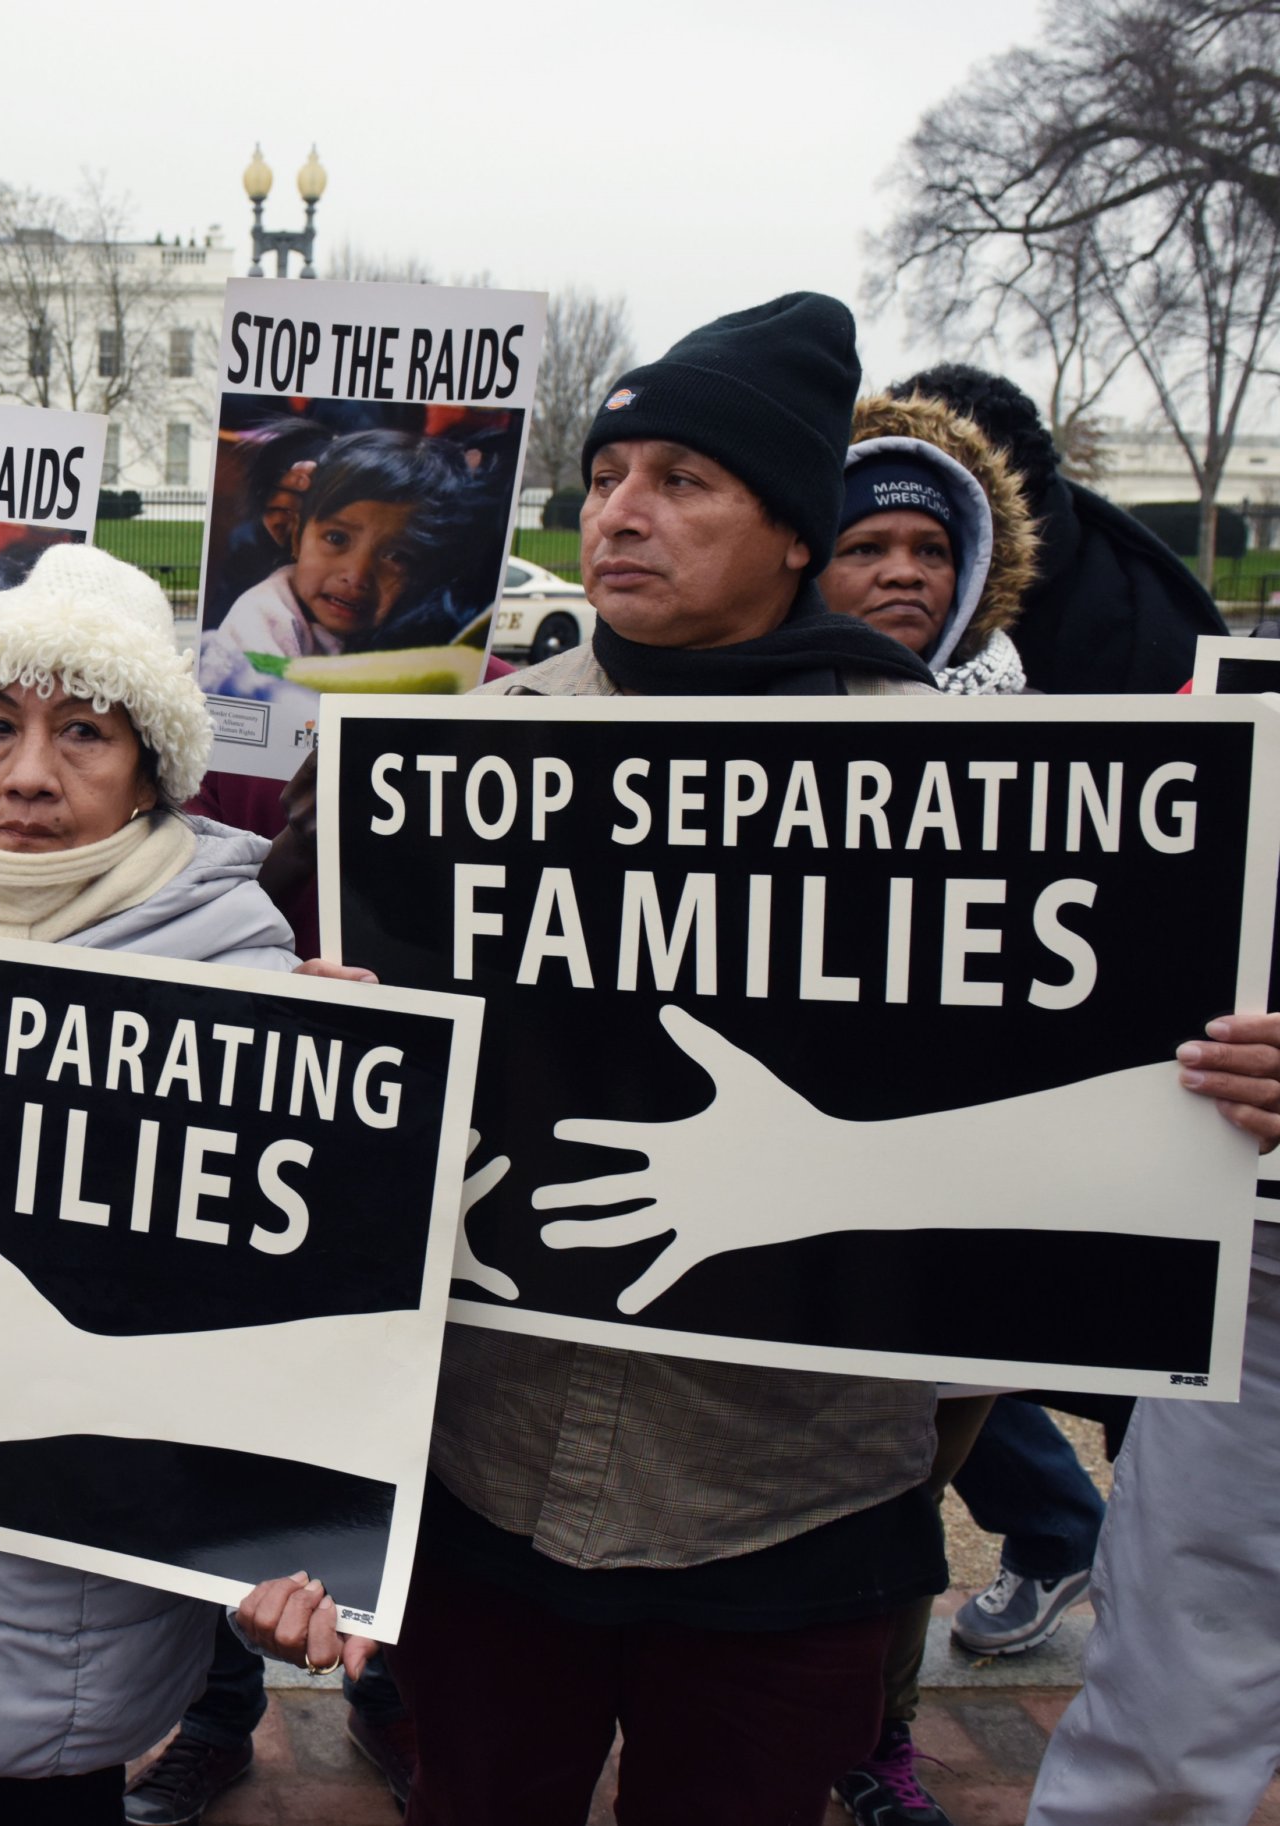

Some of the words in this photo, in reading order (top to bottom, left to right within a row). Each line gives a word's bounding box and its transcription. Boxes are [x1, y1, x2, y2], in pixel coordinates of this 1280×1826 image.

[227, 312, 321, 393] STOP
[332, 325, 400, 400] THE
[407, 325, 524, 401] RAIDS
[875, 492, 951, 520] WRESTLING
[228, 711, 258, 722] Community
[371, 753, 573, 841] STOP
[612, 758, 1198, 854] SEPARATING
[454, 863, 1098, 1010] FAMILIES
